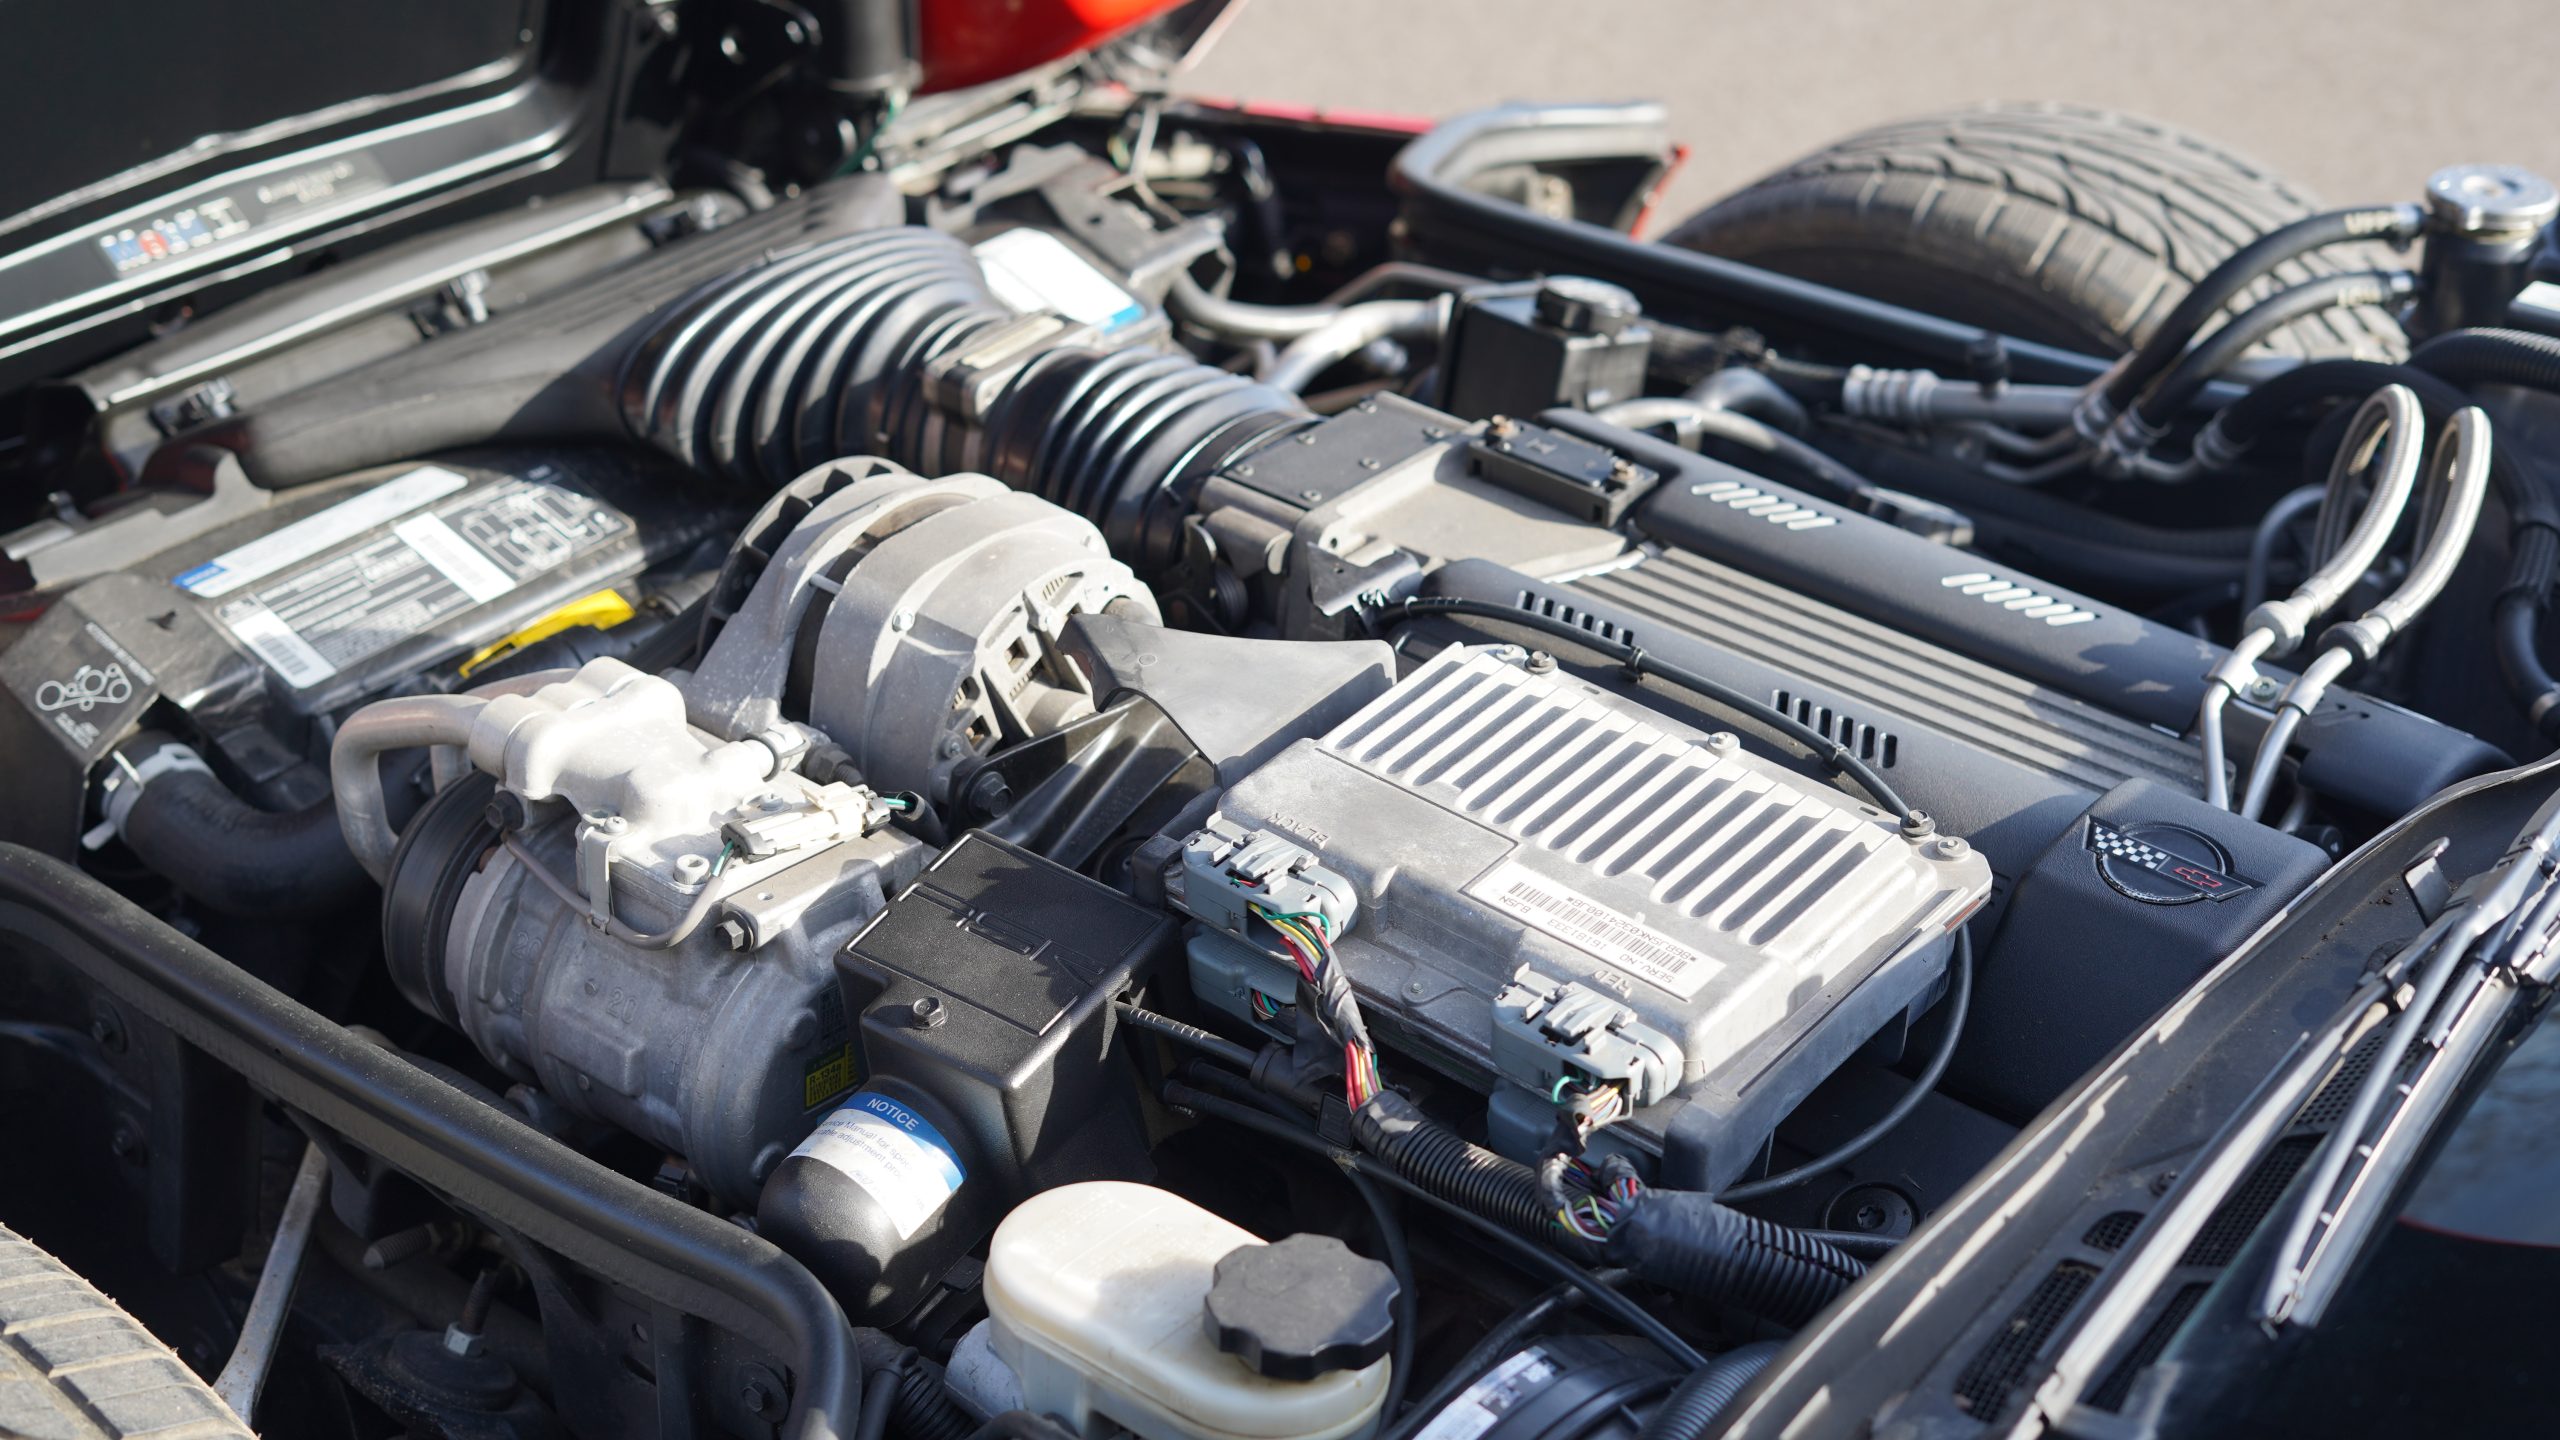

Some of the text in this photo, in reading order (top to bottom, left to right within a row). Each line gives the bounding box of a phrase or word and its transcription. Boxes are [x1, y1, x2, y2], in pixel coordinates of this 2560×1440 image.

[1266, 812, 1329, 850] BLACK
[1547, 919, 1607, 950] 16181333
[1594, 970, 1632, 998] RED
[605, 986, 637, 1024] 20
[867, 1098, 919, 1131] NOTICE
[838, 1132, 886, 1161] adjustment
[845, 1121, 876, 1139] Manual
[877, 1137, 890, 1148] for
